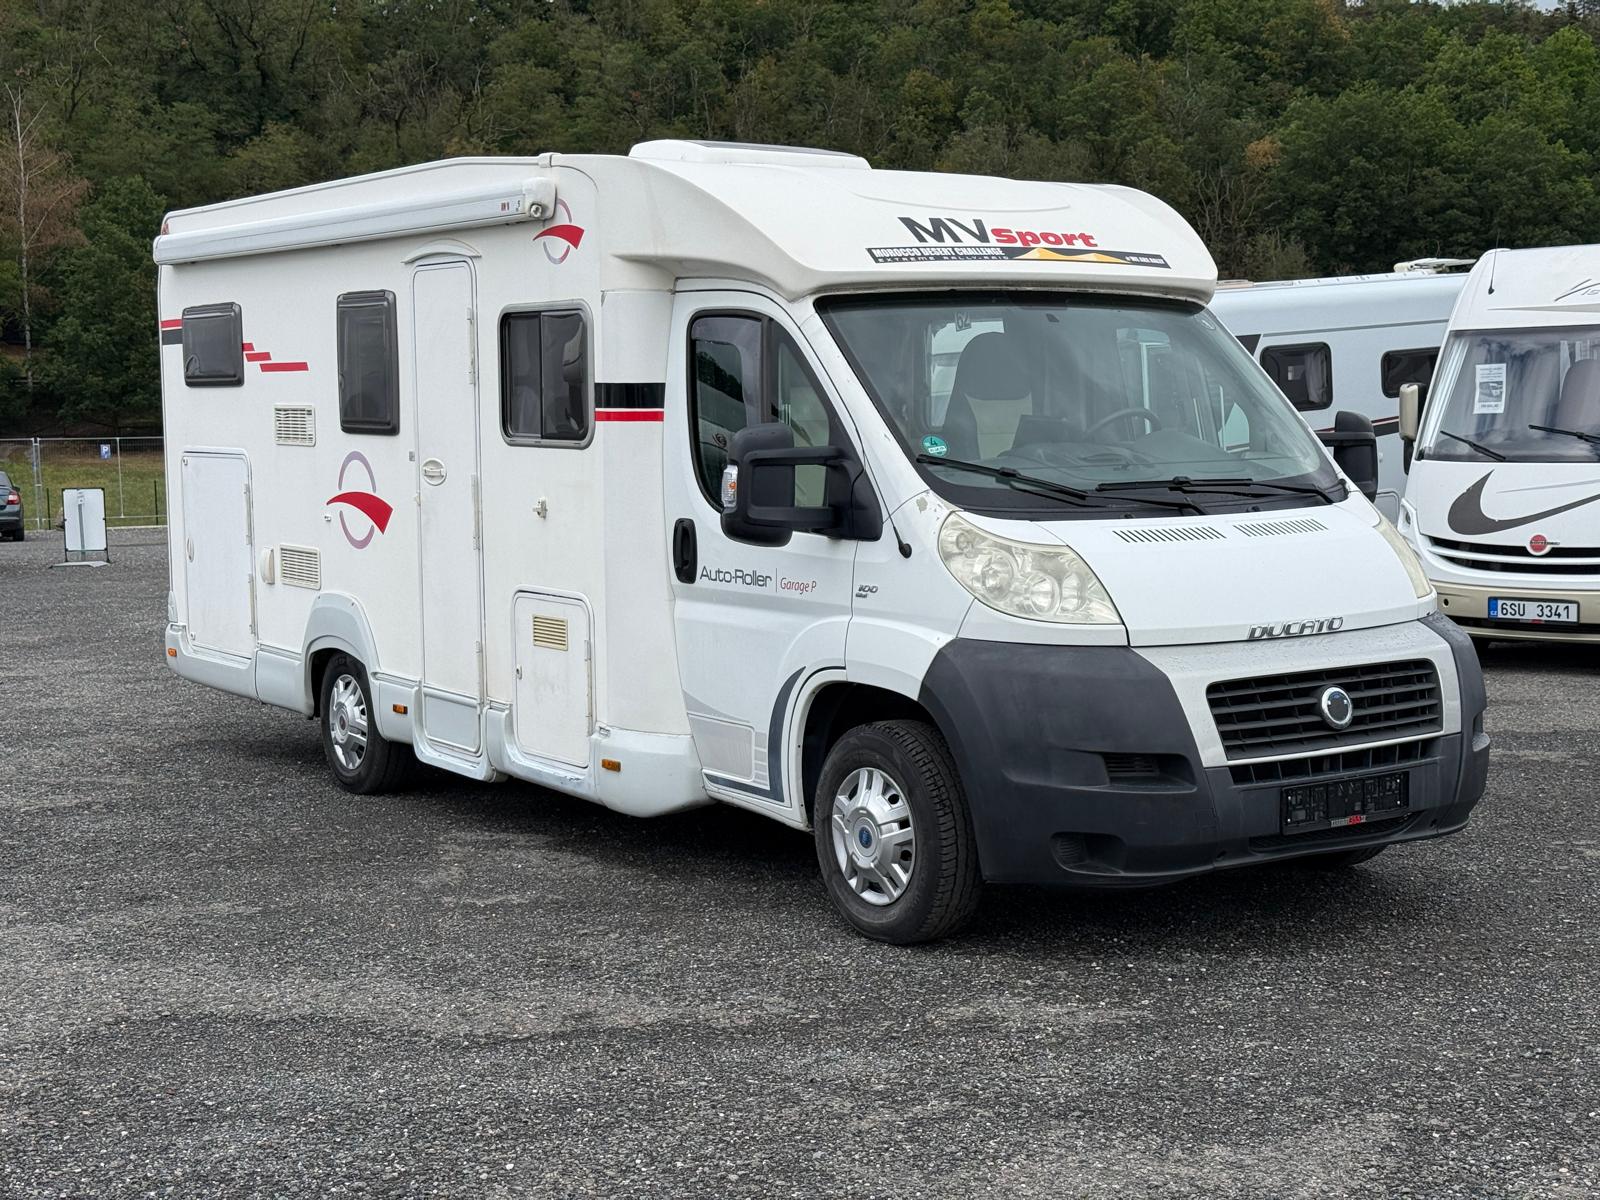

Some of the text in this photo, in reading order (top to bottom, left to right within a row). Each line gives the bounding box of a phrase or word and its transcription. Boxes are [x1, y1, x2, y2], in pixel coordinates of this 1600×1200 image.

[871, 247, 1006, 257] MOROCCO DESERT CHALLENGE
[700, 565, 817, 595] Auto-Roller Garage P
[1501, 602, 1526, 617] 6SU
[1536, 604, 1570, 619] 3341
[1248, 616, 1344, 640] DUCATO
